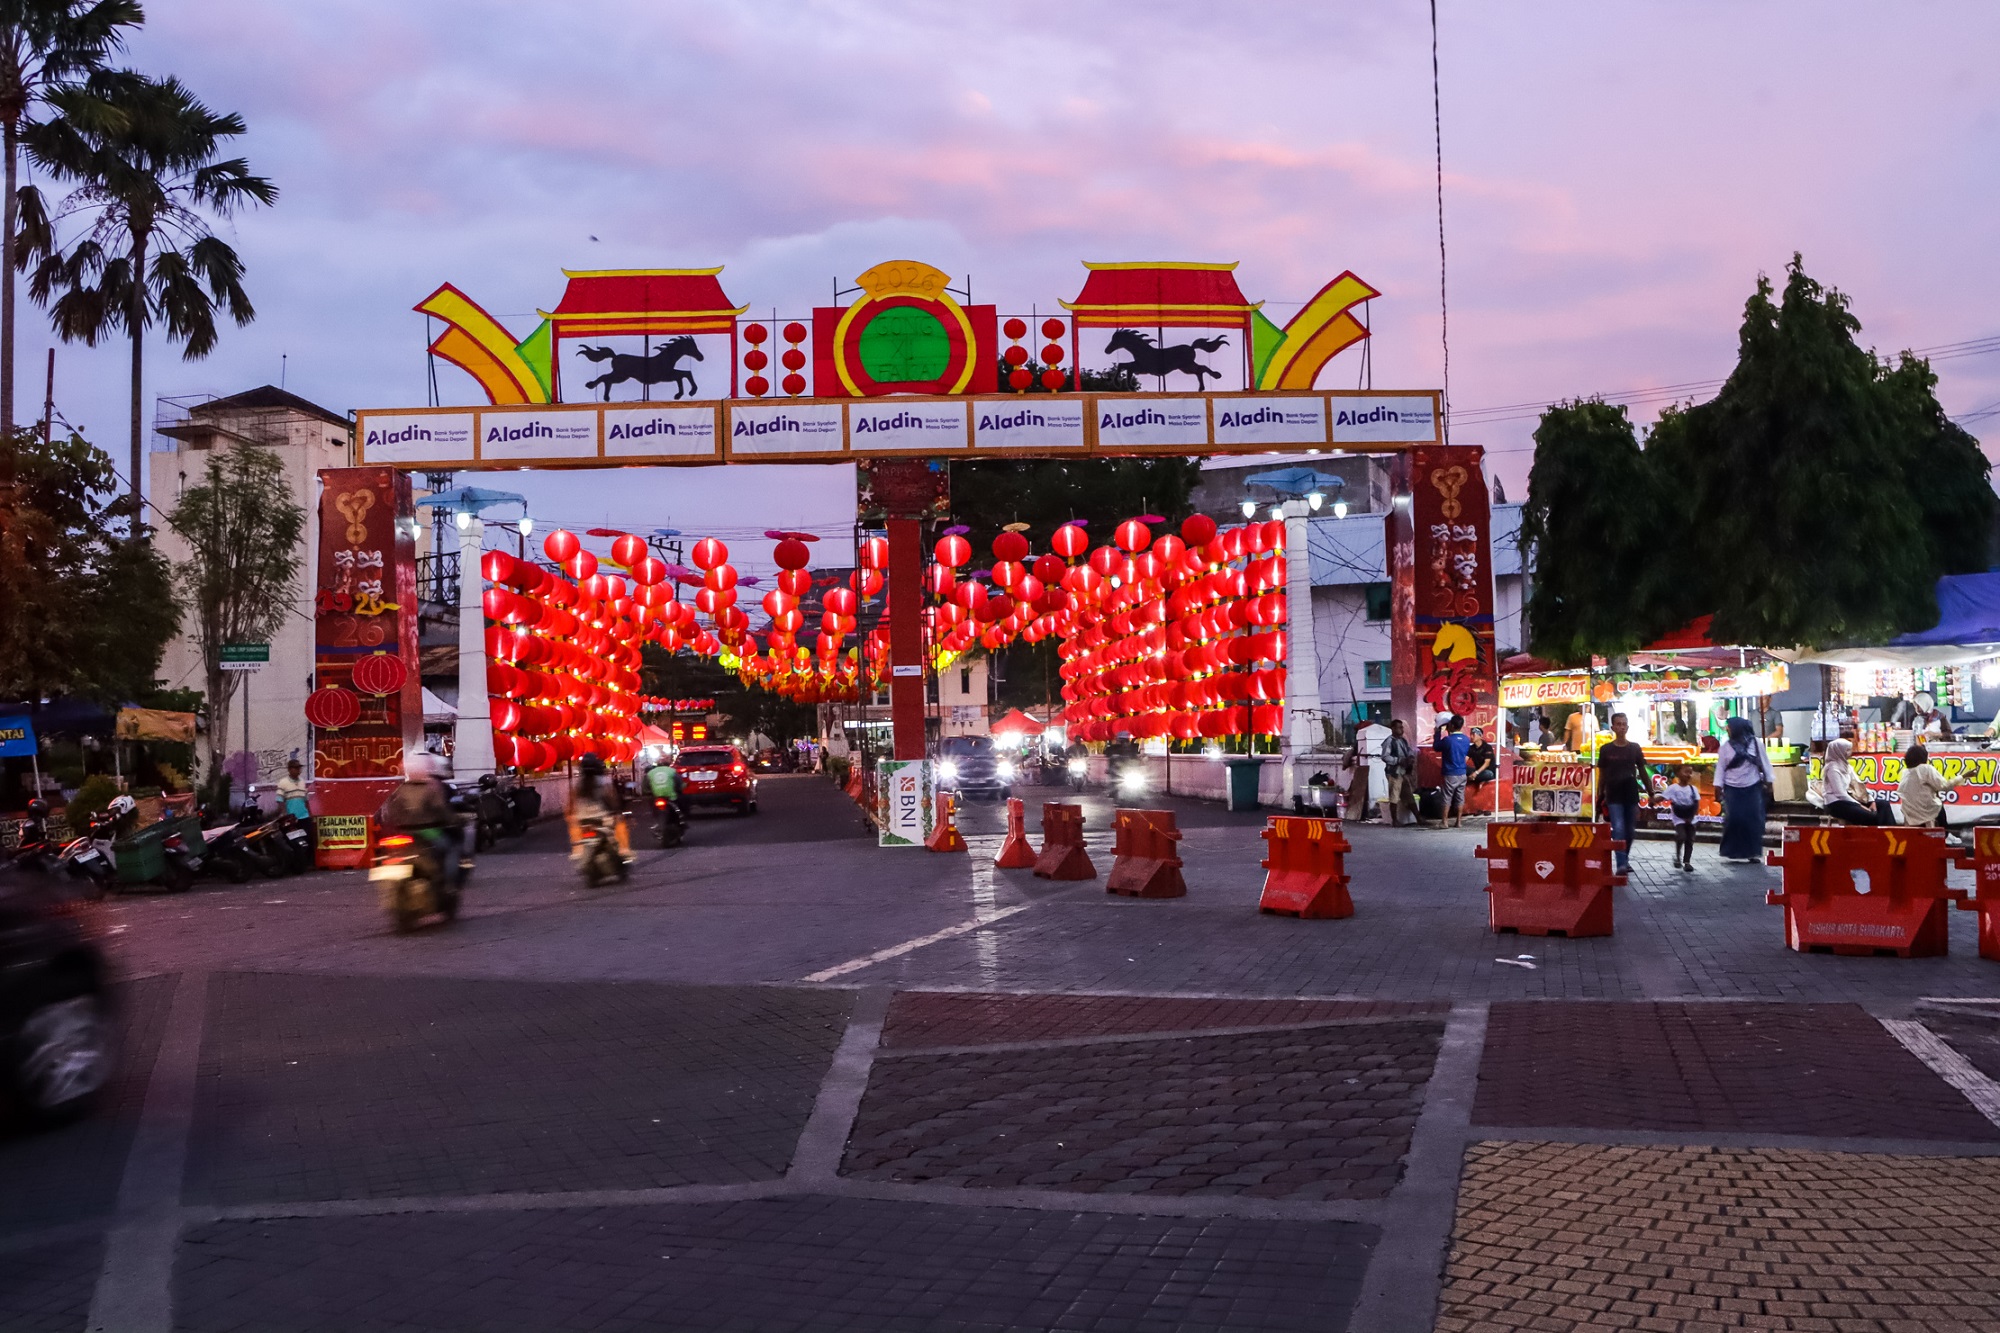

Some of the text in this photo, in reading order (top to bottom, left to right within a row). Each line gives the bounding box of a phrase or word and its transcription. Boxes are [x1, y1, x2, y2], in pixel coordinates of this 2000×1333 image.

[867, 267, 939, 292] 2026
[876, 317, 933, 336] GONG
[734, 415, 800, 437] Aladin
[817, 420, 837, 428] Syariah
[855, 412, 923, 433] Aladin
[978, 410, 1045, 431] Aladin
[1100, 408, 1165, 429] Aladin
[1219, 407, 1283, 427] Aladin
[1336, 406, 1398, 426] Aladin
[366, 424, 431, 445] Aladin
[487, 421, 552, 442] Aladin
[609, 418, 676, 439] Aladin
[1432, 588, 1479, 618] 26
[334, 617, 385, 647] 26
[1504, 680, 1586, 700] TAHU GEJROT
[1540, 766, 1592, 787] GEJROT
[1883, 757, 1997, 785] BARAN
[901, 795, 916, 827] BNI
[319, 817, 365, 827] PEJALAN KAKI
[320, 828, 365, 837] MASUK TROTOAR
